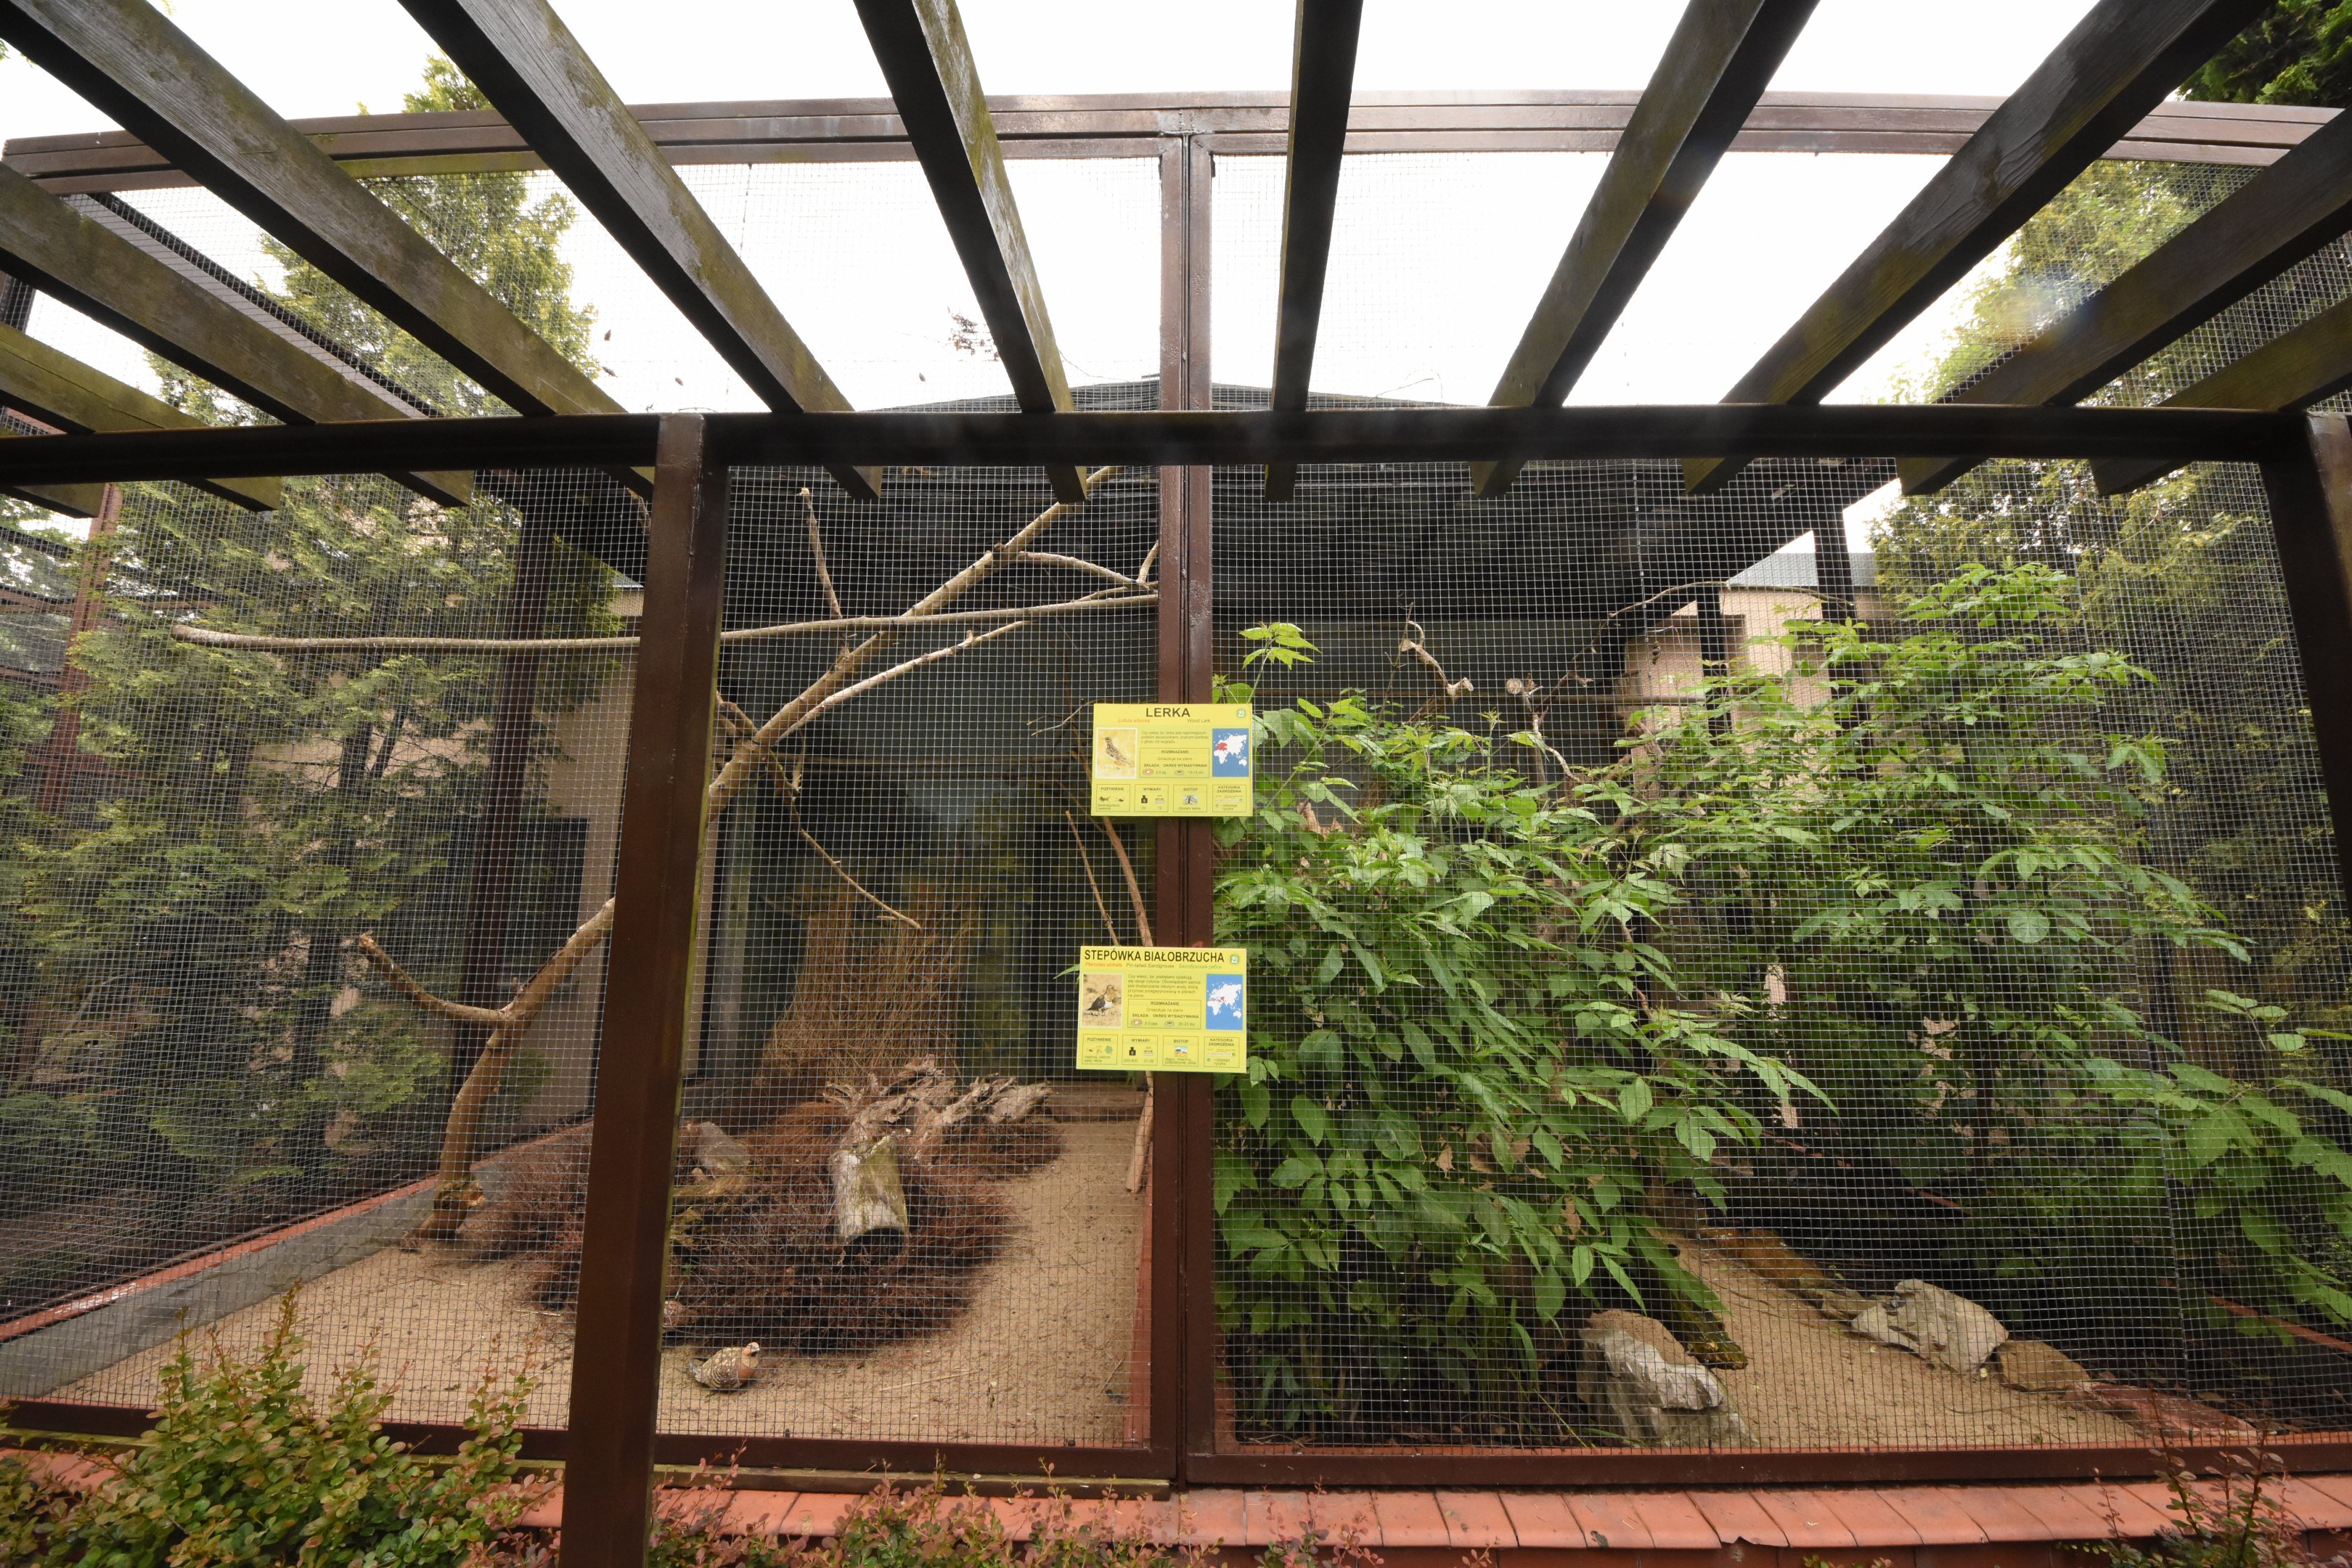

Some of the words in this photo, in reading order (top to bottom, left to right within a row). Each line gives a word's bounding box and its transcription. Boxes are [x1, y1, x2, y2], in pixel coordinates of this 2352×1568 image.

[1146, 708, 1191, 717] LERKA
[1085, 948, 1141, 960] STEPÓWKA
[1144, 951, 1225, 963] BIAŁOBRZUCHA
